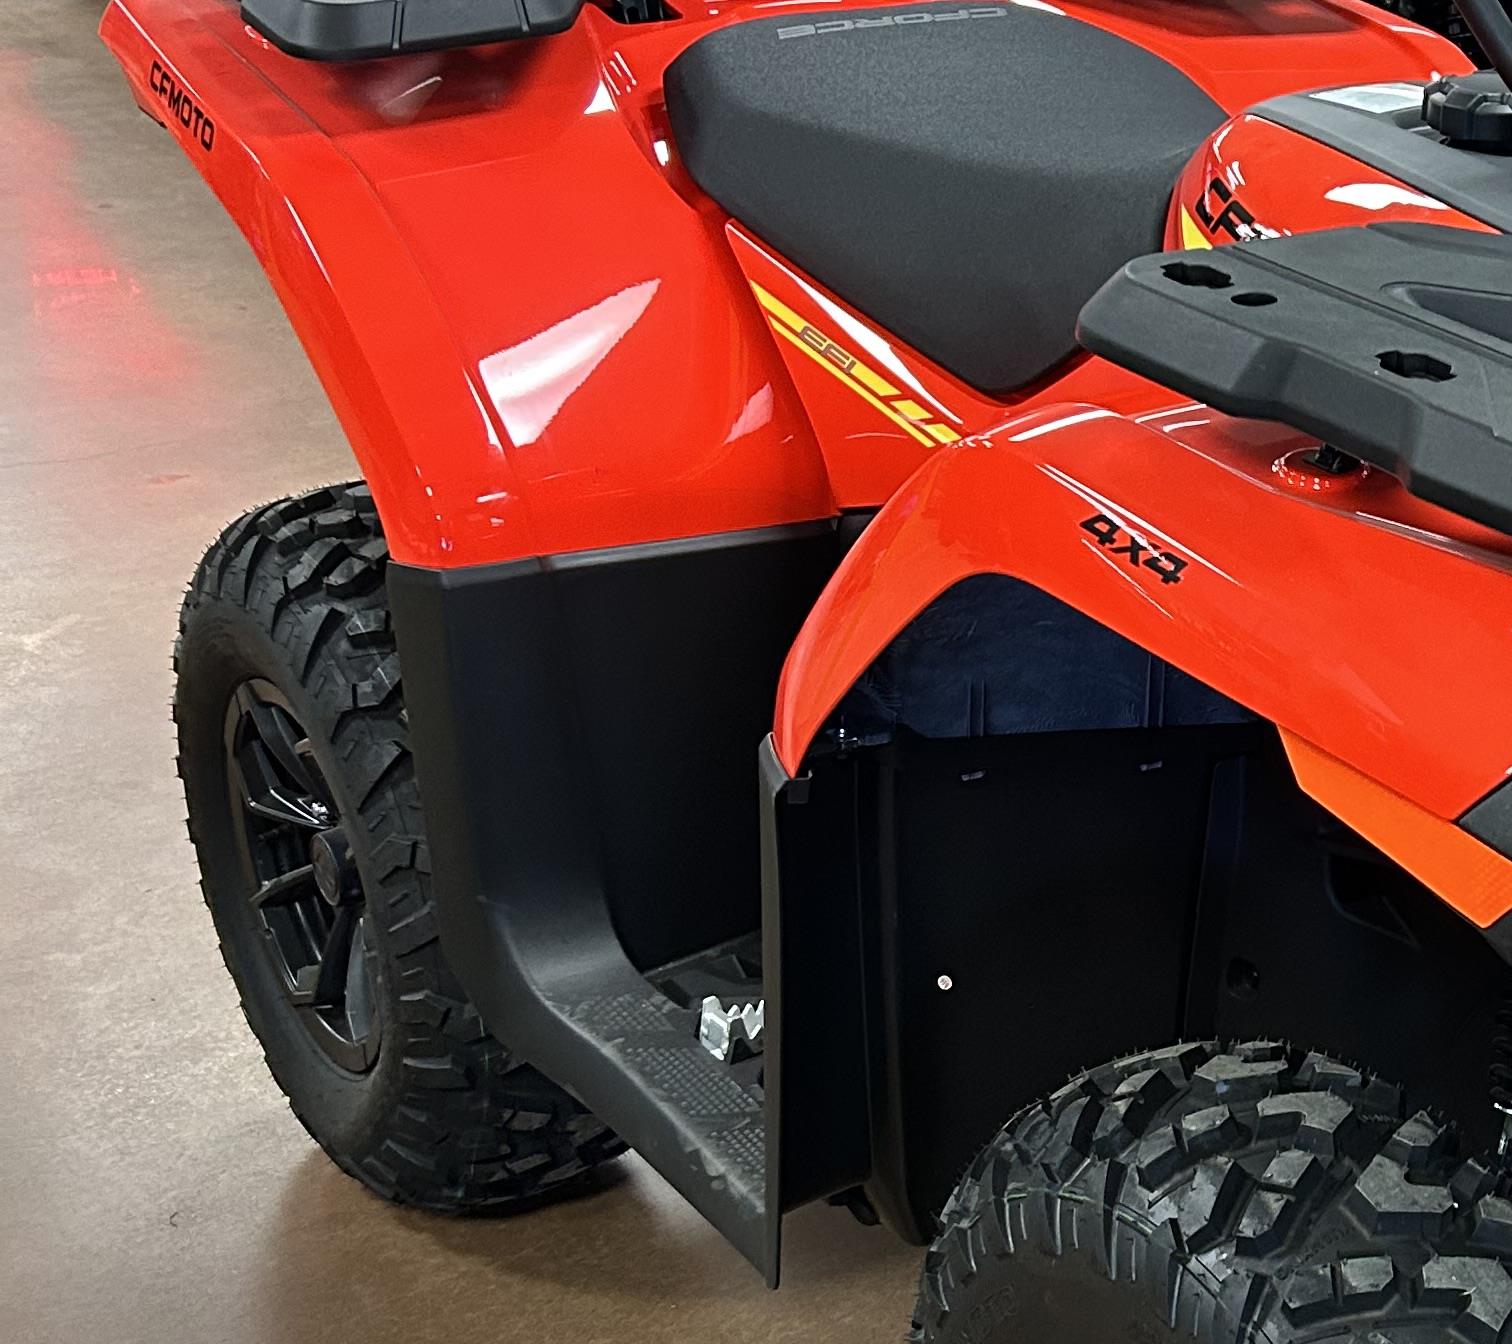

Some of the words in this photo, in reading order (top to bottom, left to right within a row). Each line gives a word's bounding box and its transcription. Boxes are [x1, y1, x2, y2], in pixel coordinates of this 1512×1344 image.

[776, 7, 1008, 40] CFORCE
[150, 59, 215, 152] CFMOTO
[798, 325, 857, 375] EFI
